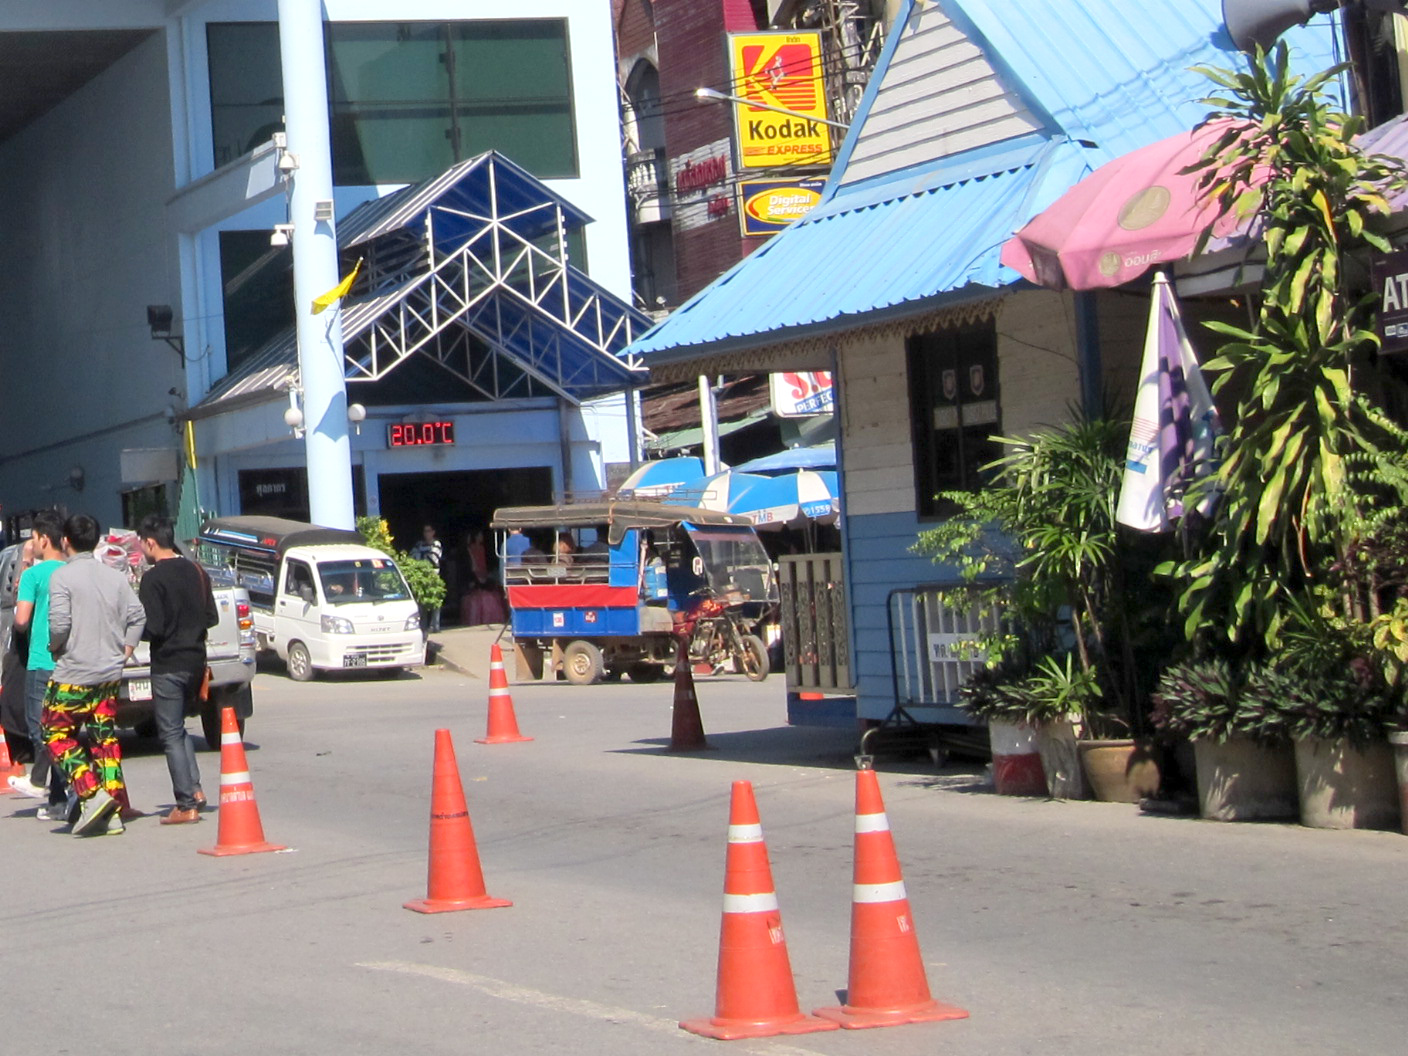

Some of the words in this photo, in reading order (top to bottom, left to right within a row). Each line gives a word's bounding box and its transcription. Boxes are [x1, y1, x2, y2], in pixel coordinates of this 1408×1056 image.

[749, 118, 821, 140] Kodak
[767, 144, 823, 156] EXPRESS
[769, 194, 811, 207] Digital
[767, 204, 815, 216] Service
[796, 390, 833, 413] PERFEC
[752, 509, 774, 524] TMB
